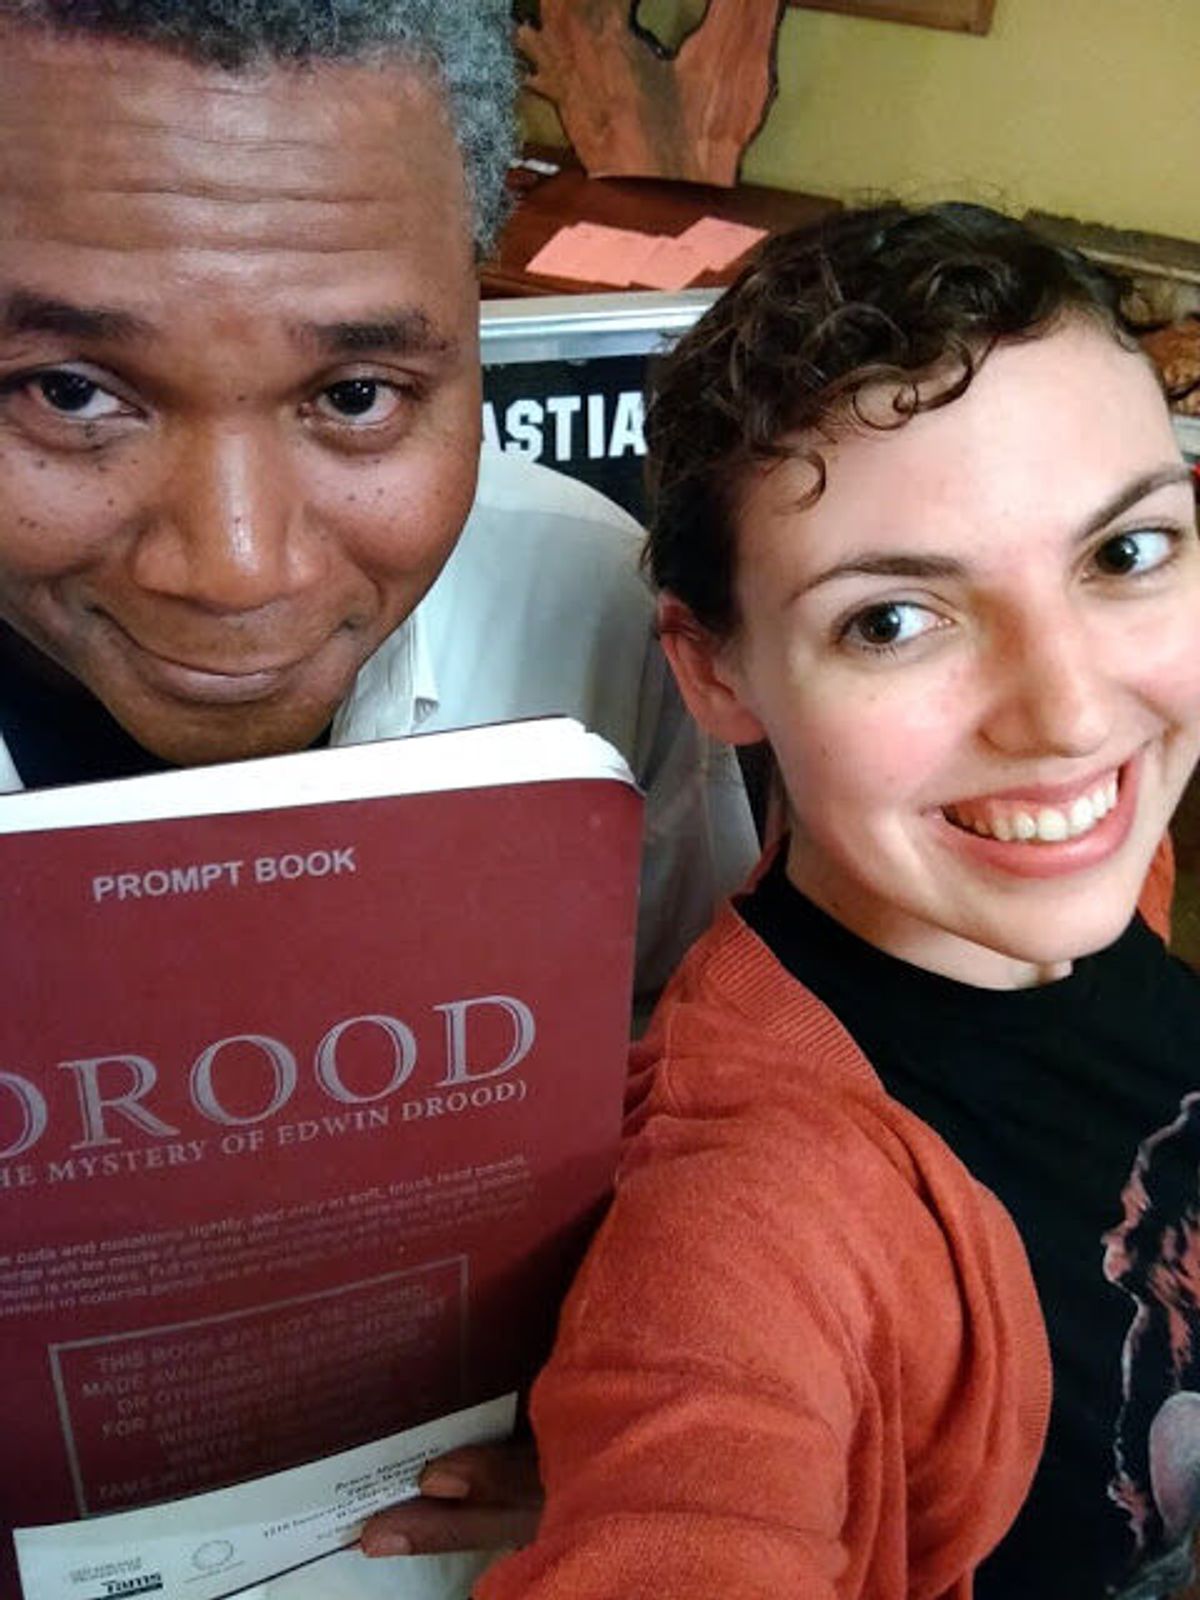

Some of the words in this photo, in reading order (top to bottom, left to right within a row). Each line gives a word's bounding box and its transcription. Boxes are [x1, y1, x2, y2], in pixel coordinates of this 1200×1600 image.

[92, 862, 243, 902] PROMPT
[254, 846, 357, 883] BOOK
[48, 1139, 207, 1184] MYSTERY
[221, 1129, 266, 1156] OF
[276, 1107, 389, 1147] EDWIN
[401, 1079, 528, 1125] DROOD)
